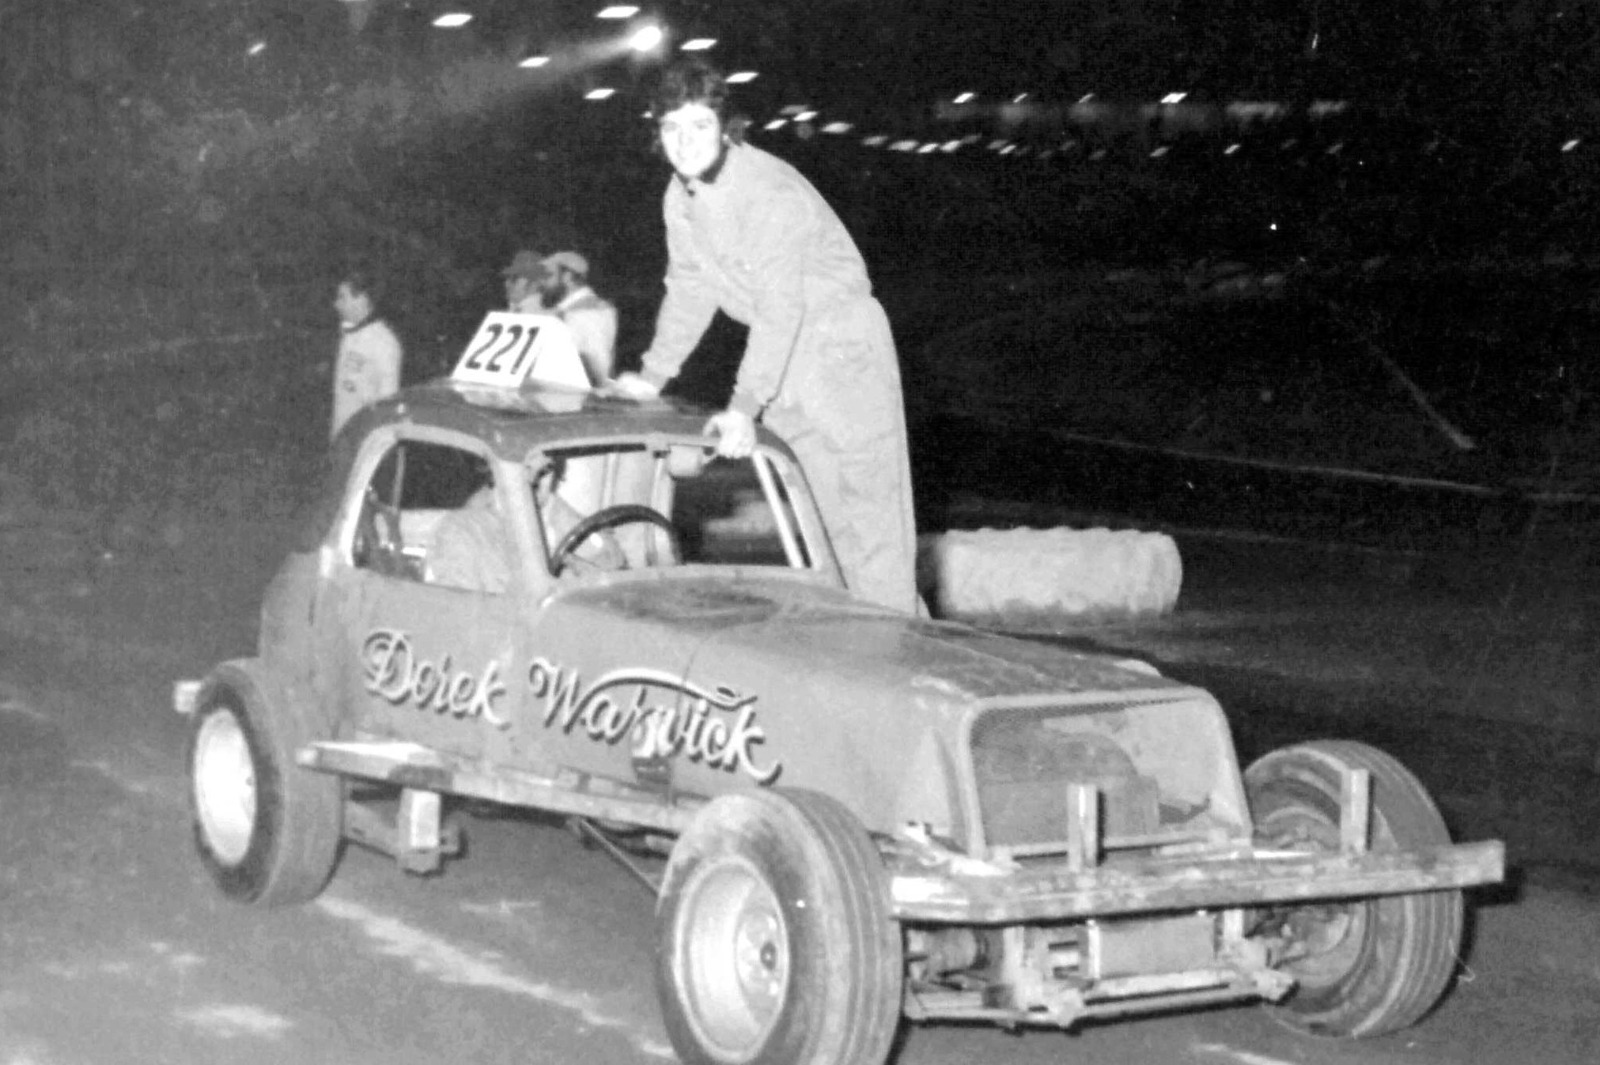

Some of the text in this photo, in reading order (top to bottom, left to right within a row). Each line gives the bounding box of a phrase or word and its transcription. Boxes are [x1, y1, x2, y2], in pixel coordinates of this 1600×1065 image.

[465, 323, 540, 375] 221
[363, 630, 782, 786] Derek Warwick
